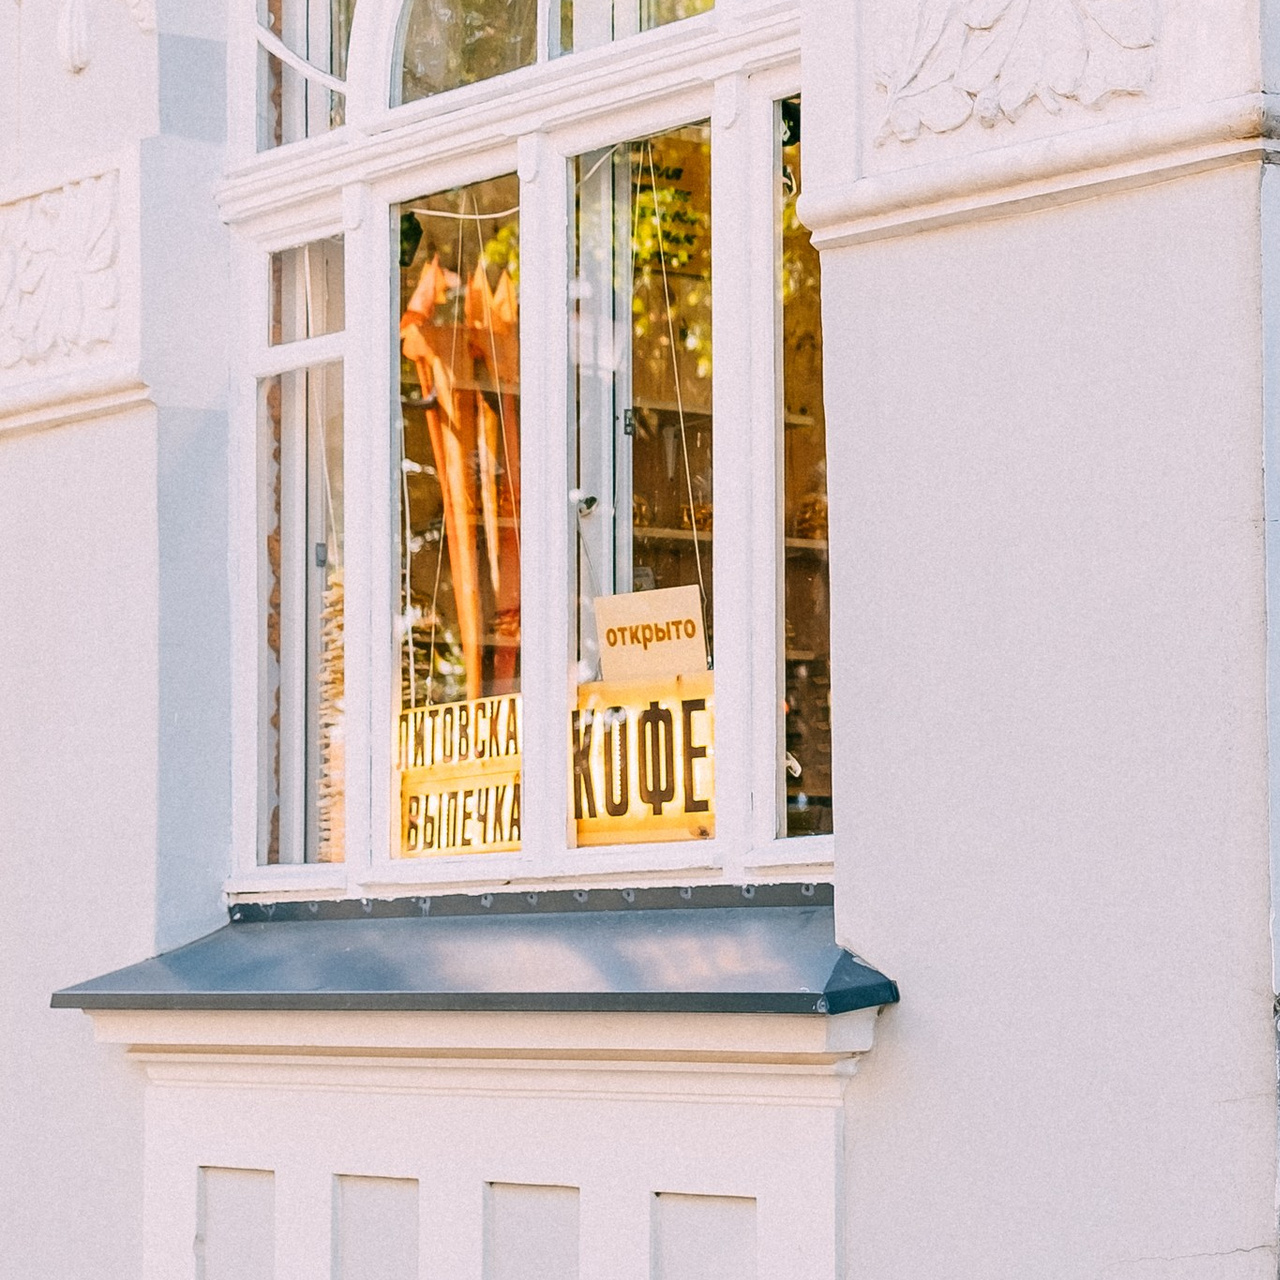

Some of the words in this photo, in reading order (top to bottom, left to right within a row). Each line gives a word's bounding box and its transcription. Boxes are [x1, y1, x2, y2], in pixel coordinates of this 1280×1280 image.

[606, 618, 697, 650] открыто
[396, 698, 519, 770] ЛИТОВСКА
[571, 699, 709, 819] КОФЕ
[407, 783, 521, 851] ВЫПЕЧКА
